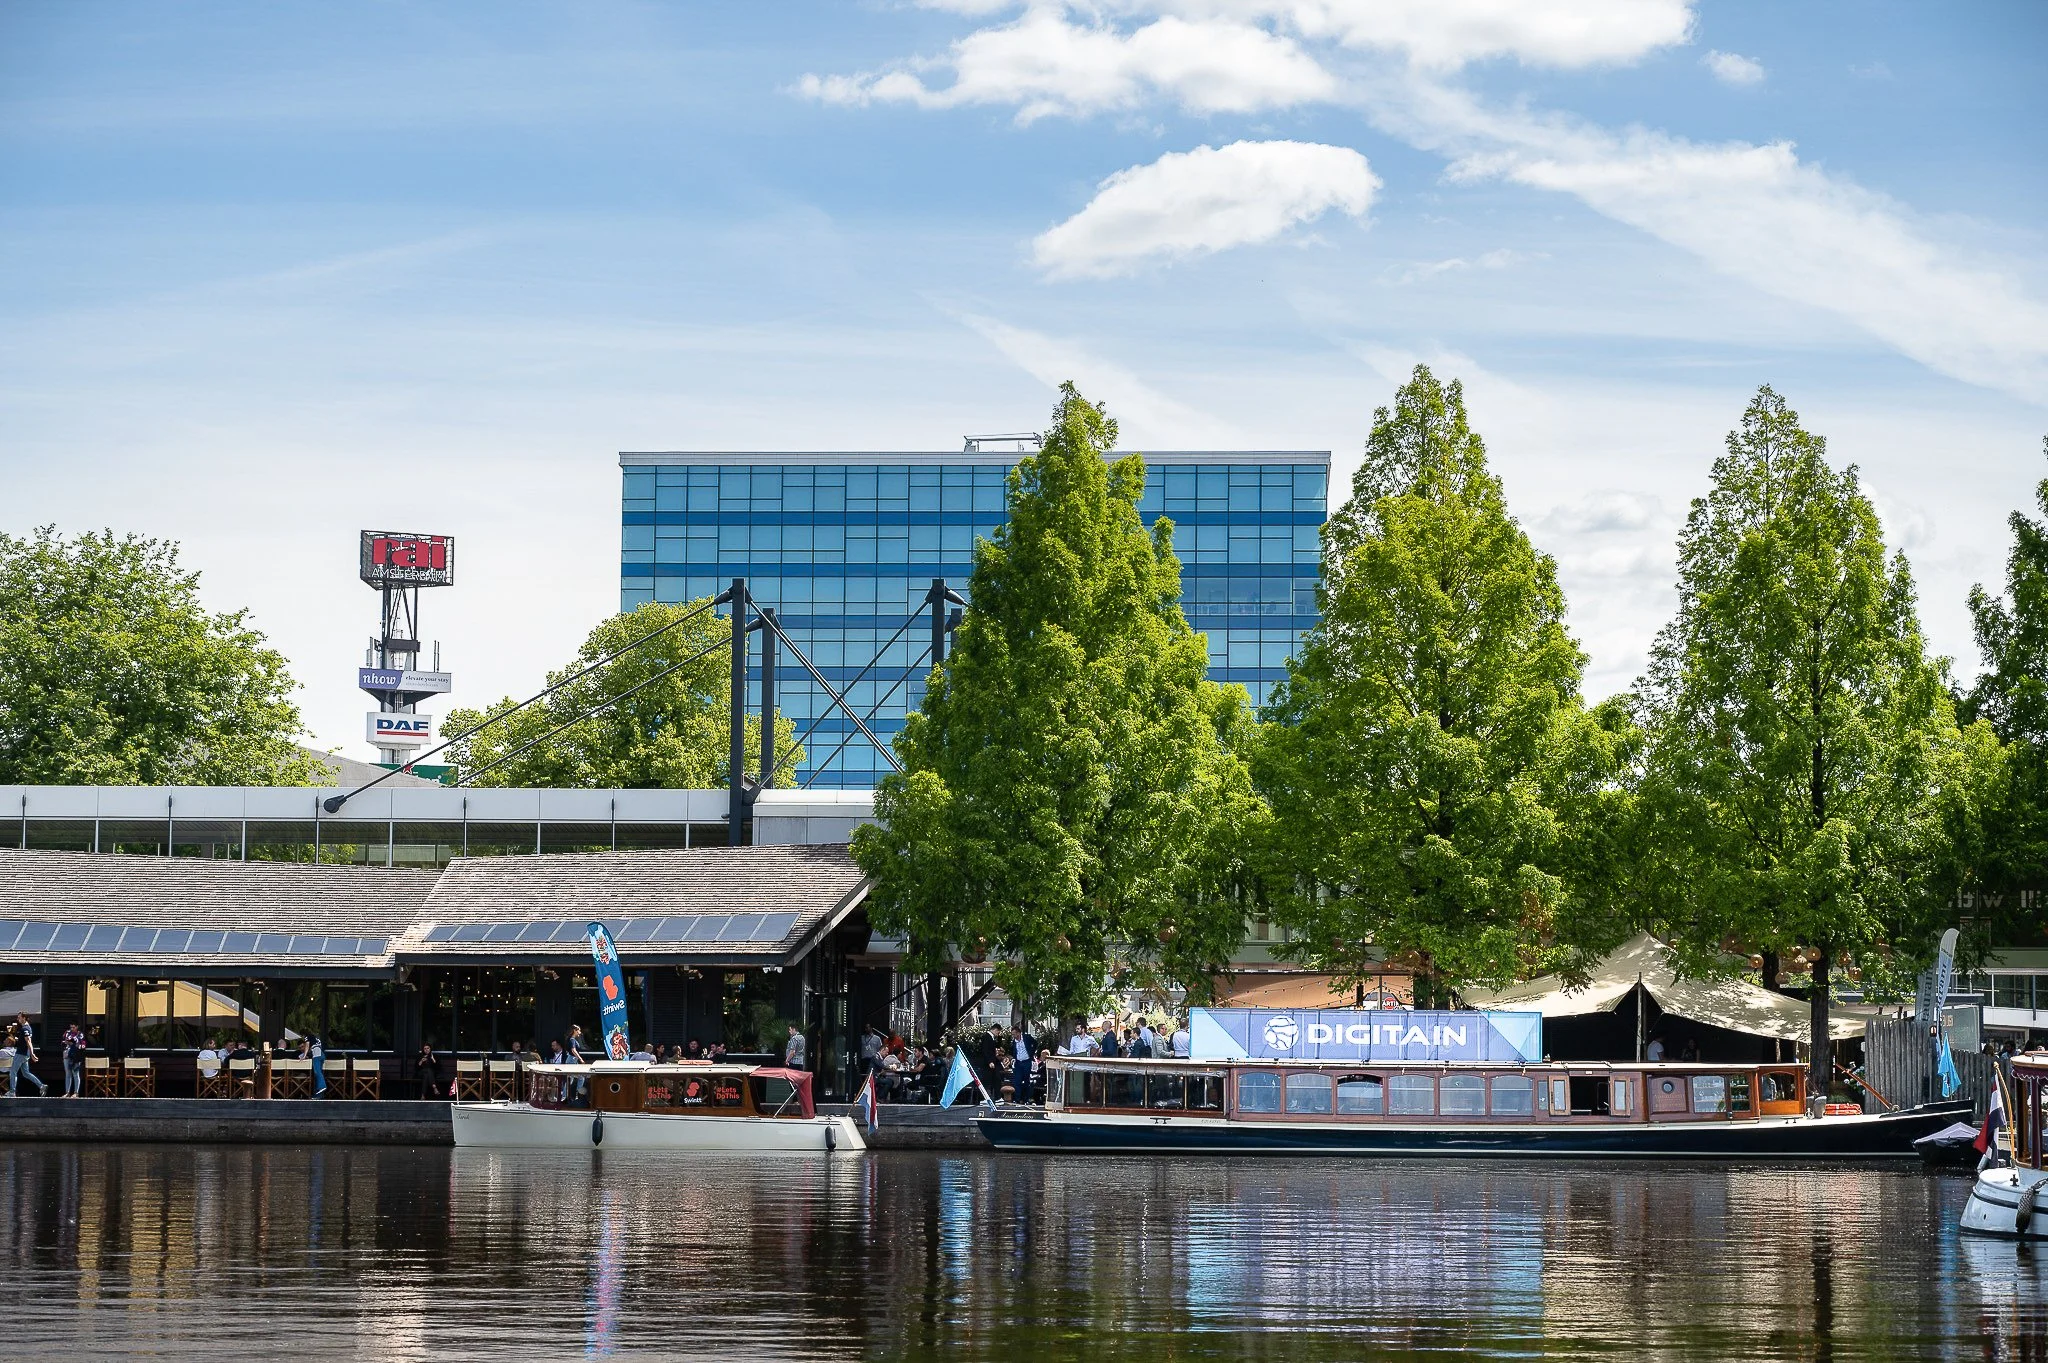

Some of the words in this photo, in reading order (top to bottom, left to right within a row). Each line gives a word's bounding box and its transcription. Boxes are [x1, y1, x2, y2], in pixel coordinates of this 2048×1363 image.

[373, 535, 445, 569] rai
[362, 673, 397, 685] nhow
[377, 718, 429, 731] DAF
[1307, 1023, 1467, 1046] DIGITAIN
